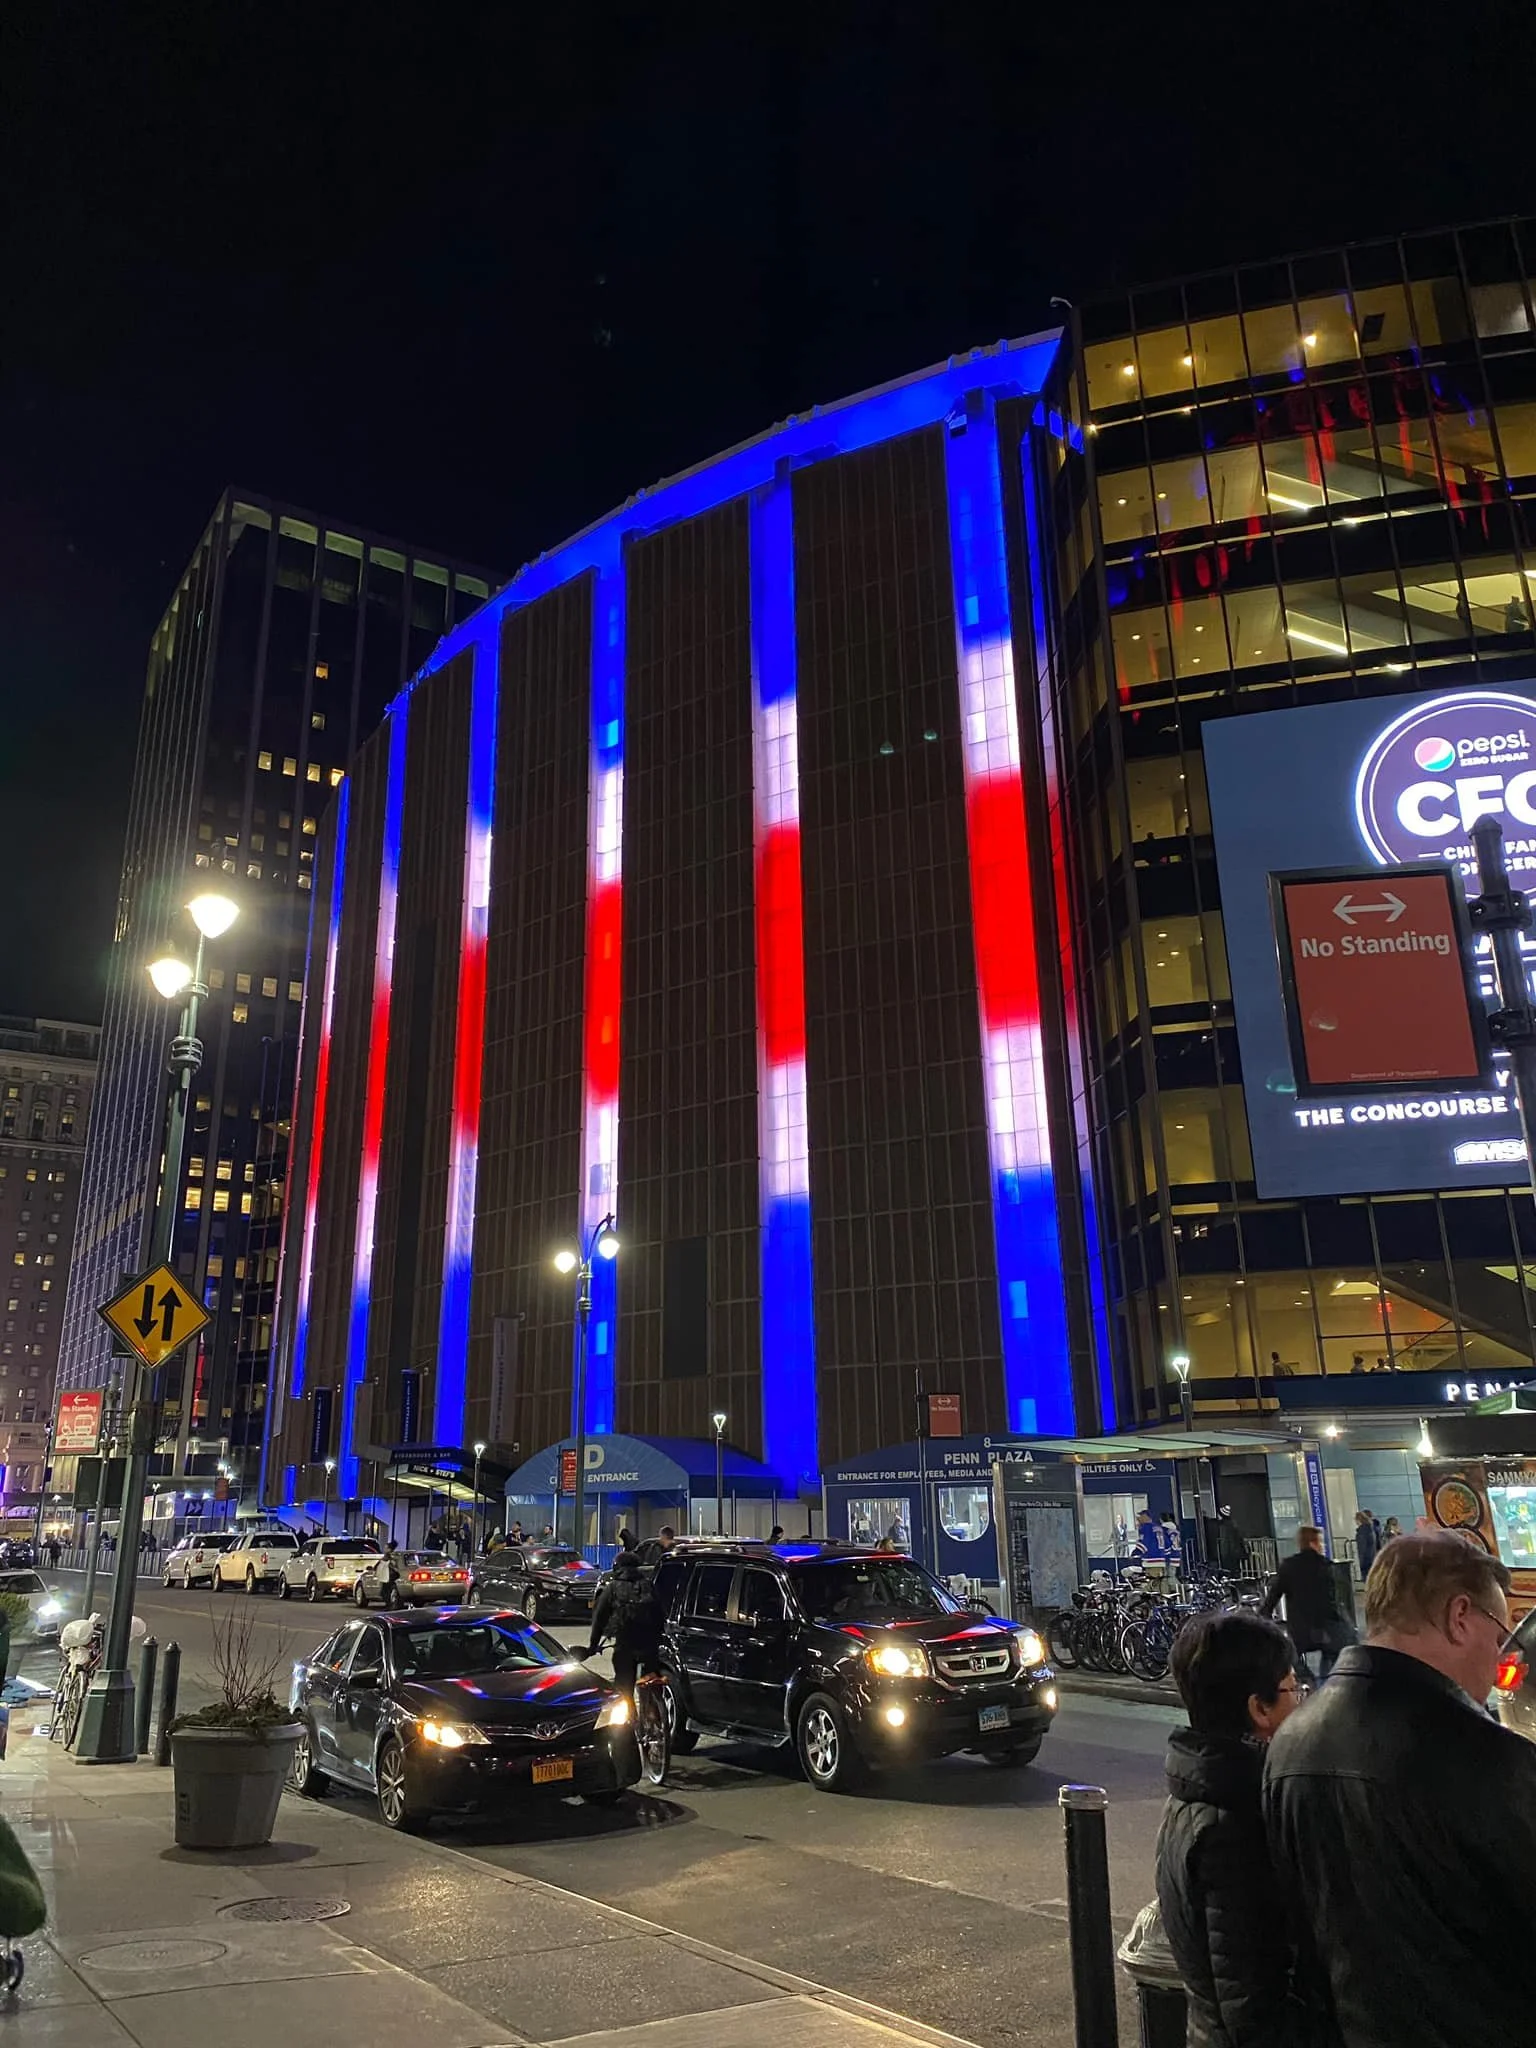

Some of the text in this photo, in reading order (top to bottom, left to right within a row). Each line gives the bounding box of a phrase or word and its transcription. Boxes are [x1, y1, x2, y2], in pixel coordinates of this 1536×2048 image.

[1459, 752, 1529, 767] ZERO SUGAR
[1300, 937, 1335, 958] No
[1341, 931, 1450, 955] Standing
[1294, 1096, 1508, 1127] THE CONCOURSE
[983, 1437, 992, 1448] 8
[584, 1443, 605, 1470] D
[944, 1450, 1034, 1465] PENN PLAZA
[587, 1472, 639, 1483] ENTRANCE
[837, 1472, 879, 1481] ENTRANCE
[879, 1471, 896, 1480] FOR
[948, 1469, 974, 1478] MEDIA
[976, 1467, 993, 1477] AND
[1119, 1463, 1143, 1473] ONLY
[1313, 1486, 1323, 1524] Bicycle
